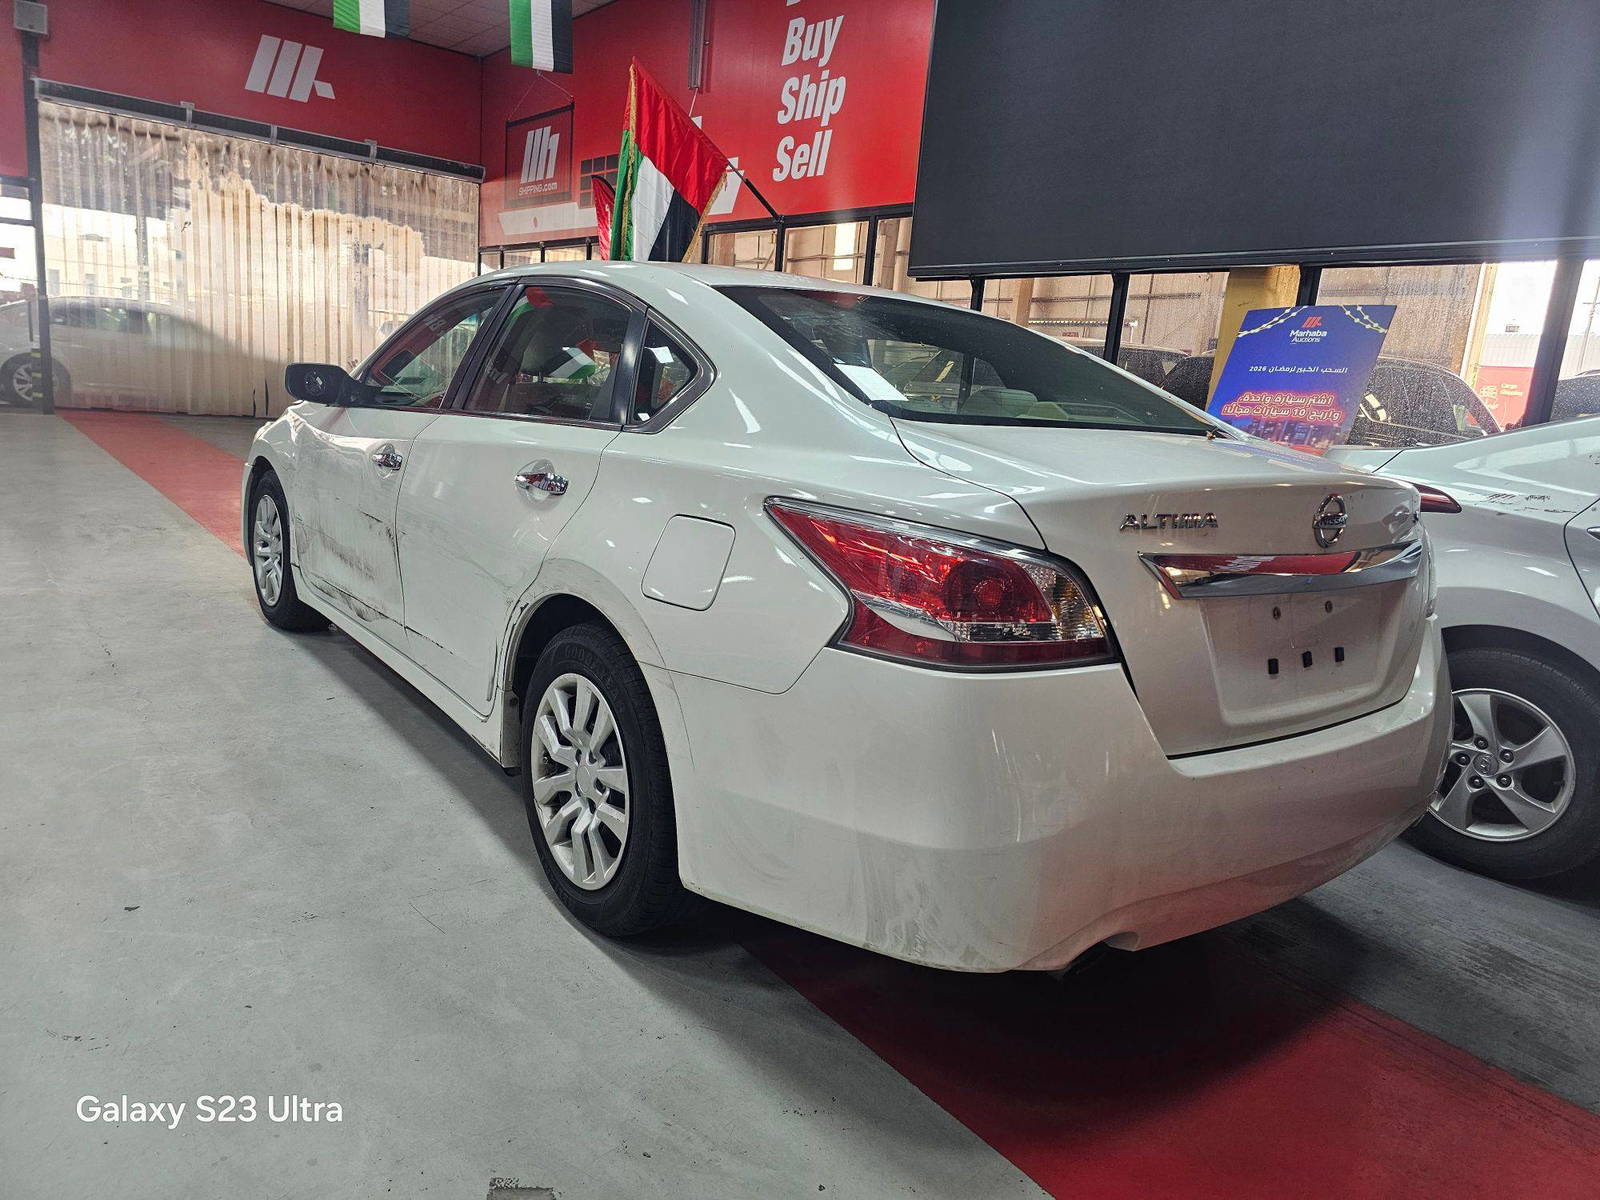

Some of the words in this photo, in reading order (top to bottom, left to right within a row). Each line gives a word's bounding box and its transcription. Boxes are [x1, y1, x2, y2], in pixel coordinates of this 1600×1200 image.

[781, 15, 845, 67] Buy
[777, 70, 846, 127] Ship
[772, 129, 833, 182] Sell
[1289, 329, 1328, 338] Marhaba
[1292, 408, 1306, 416] 10
[1120, 512, 1218, 531] ALTIMA
